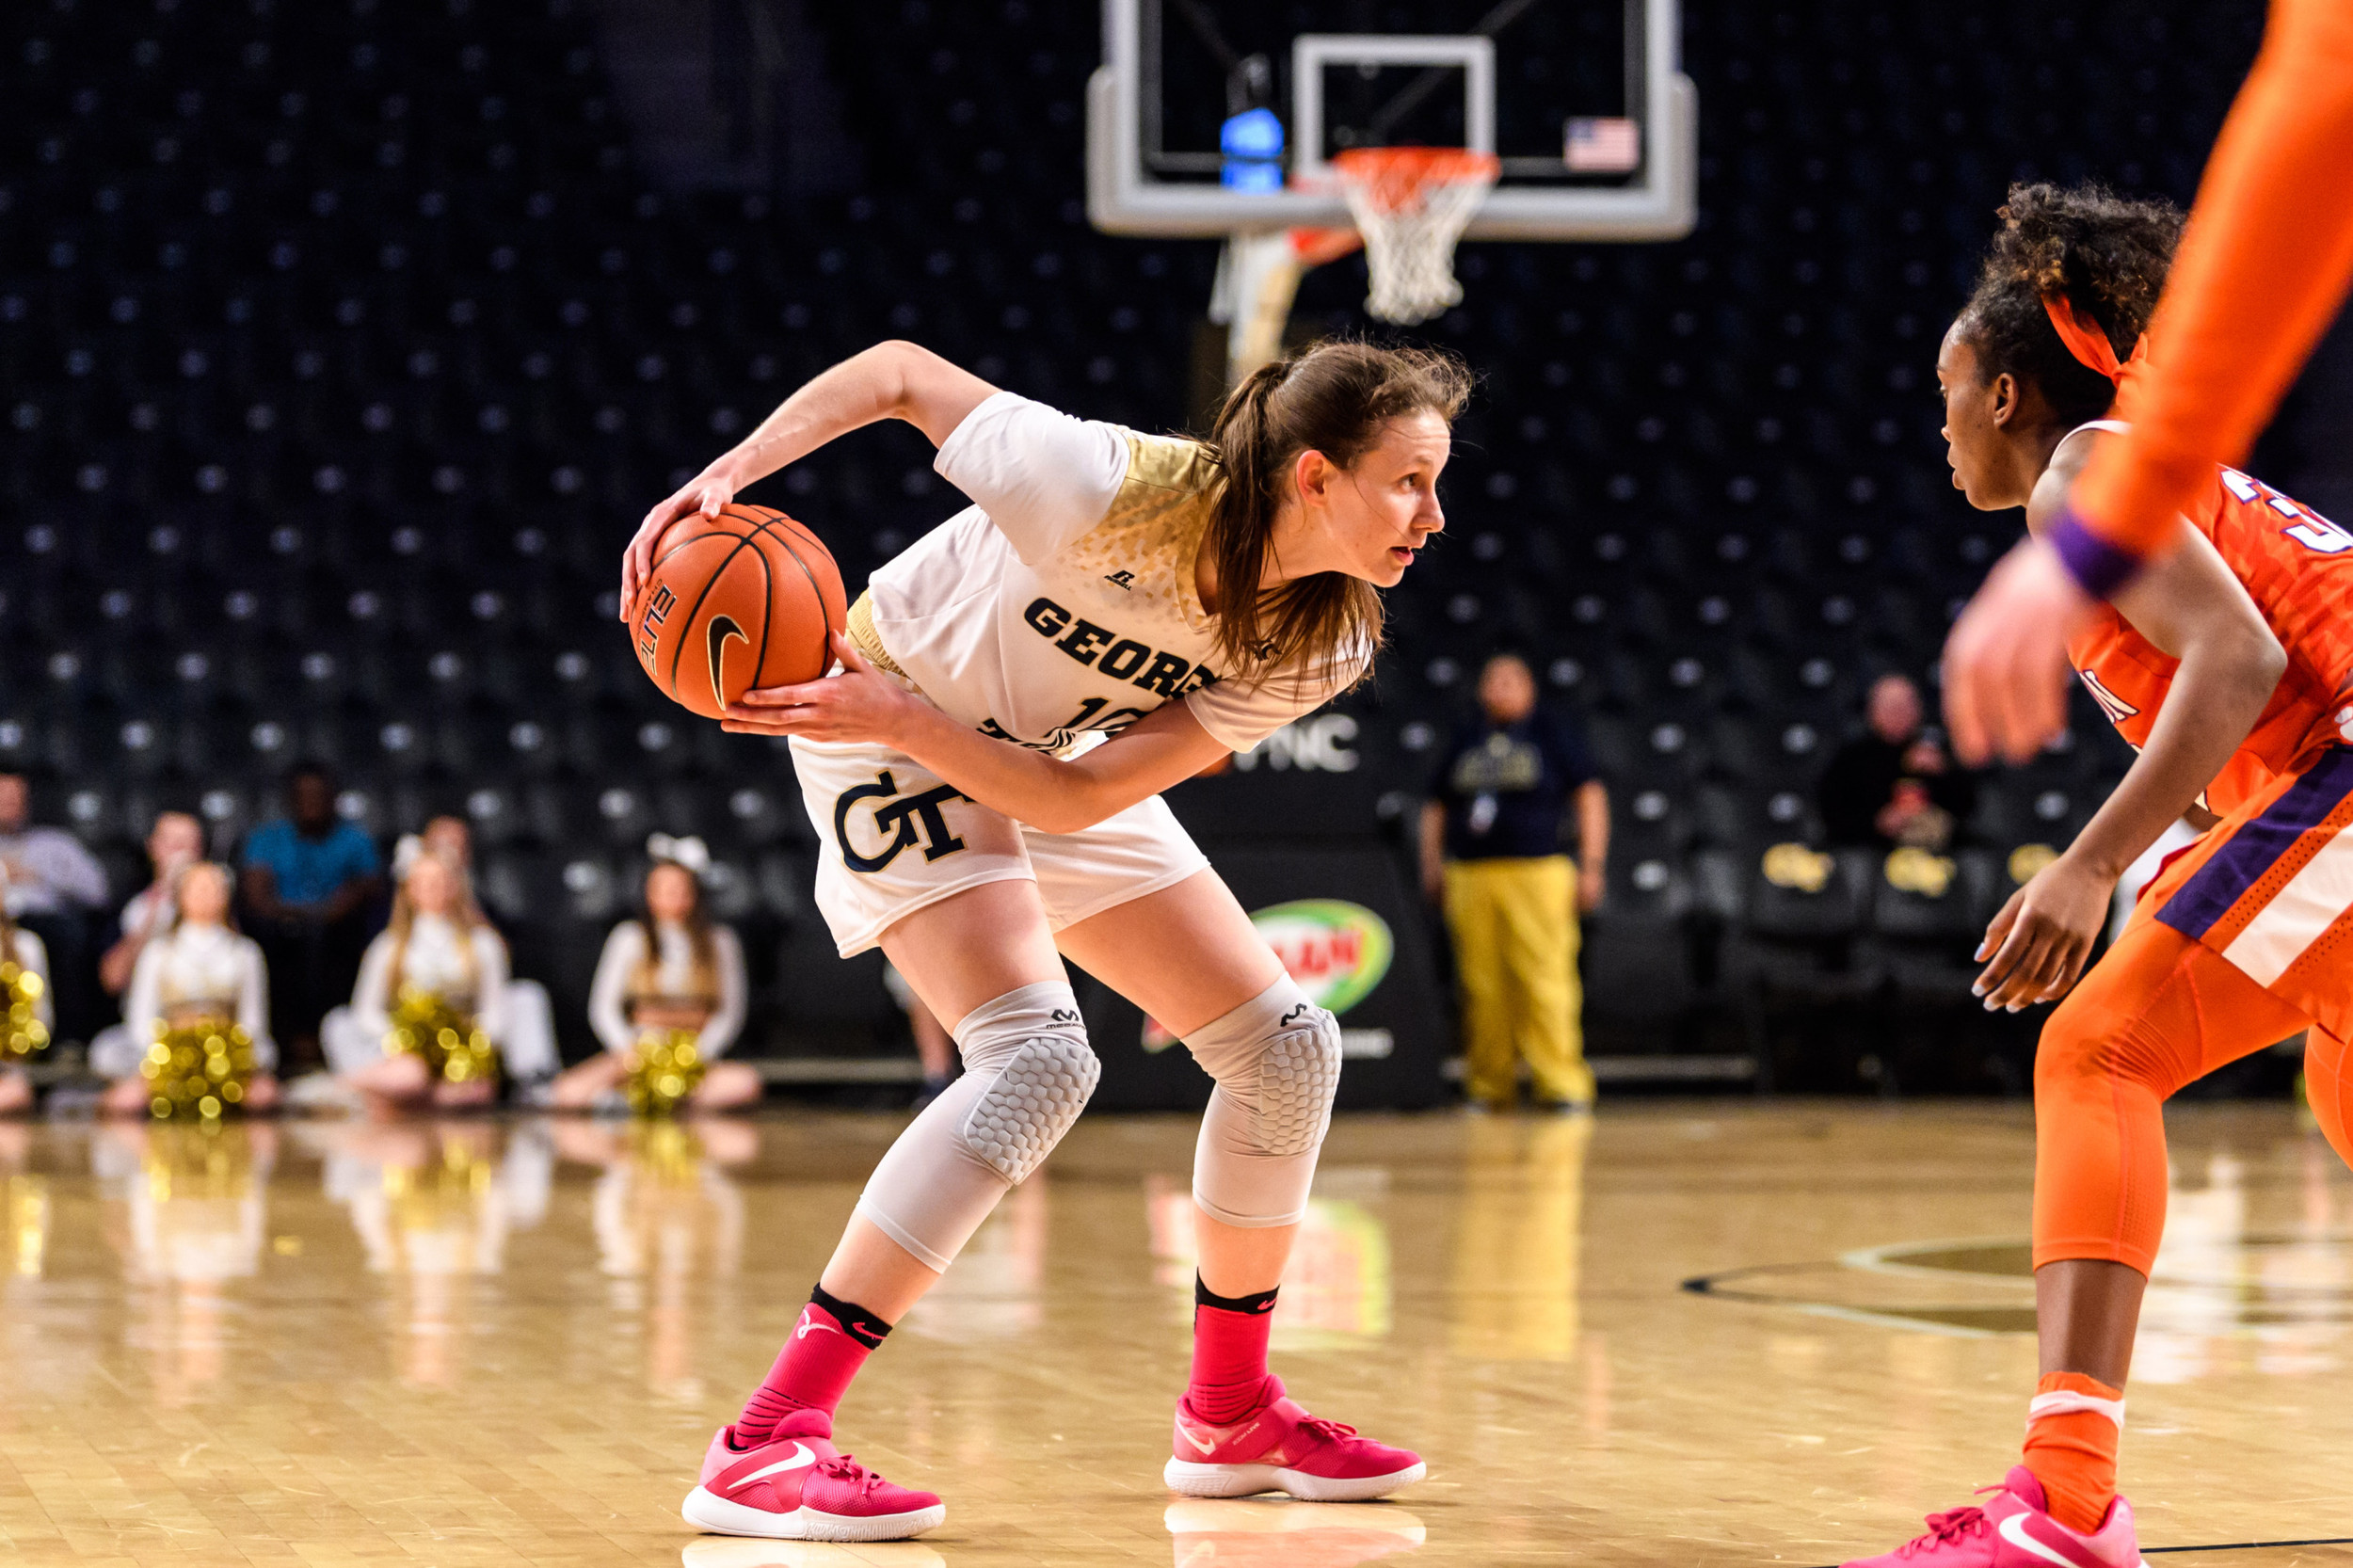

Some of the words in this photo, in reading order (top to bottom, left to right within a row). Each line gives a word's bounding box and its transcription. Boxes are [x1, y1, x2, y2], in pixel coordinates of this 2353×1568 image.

[640, 584, 677, 677] ELITE
[1023, 597, 1222, 701] GEORG
[834, 767, 979, 873] GT
